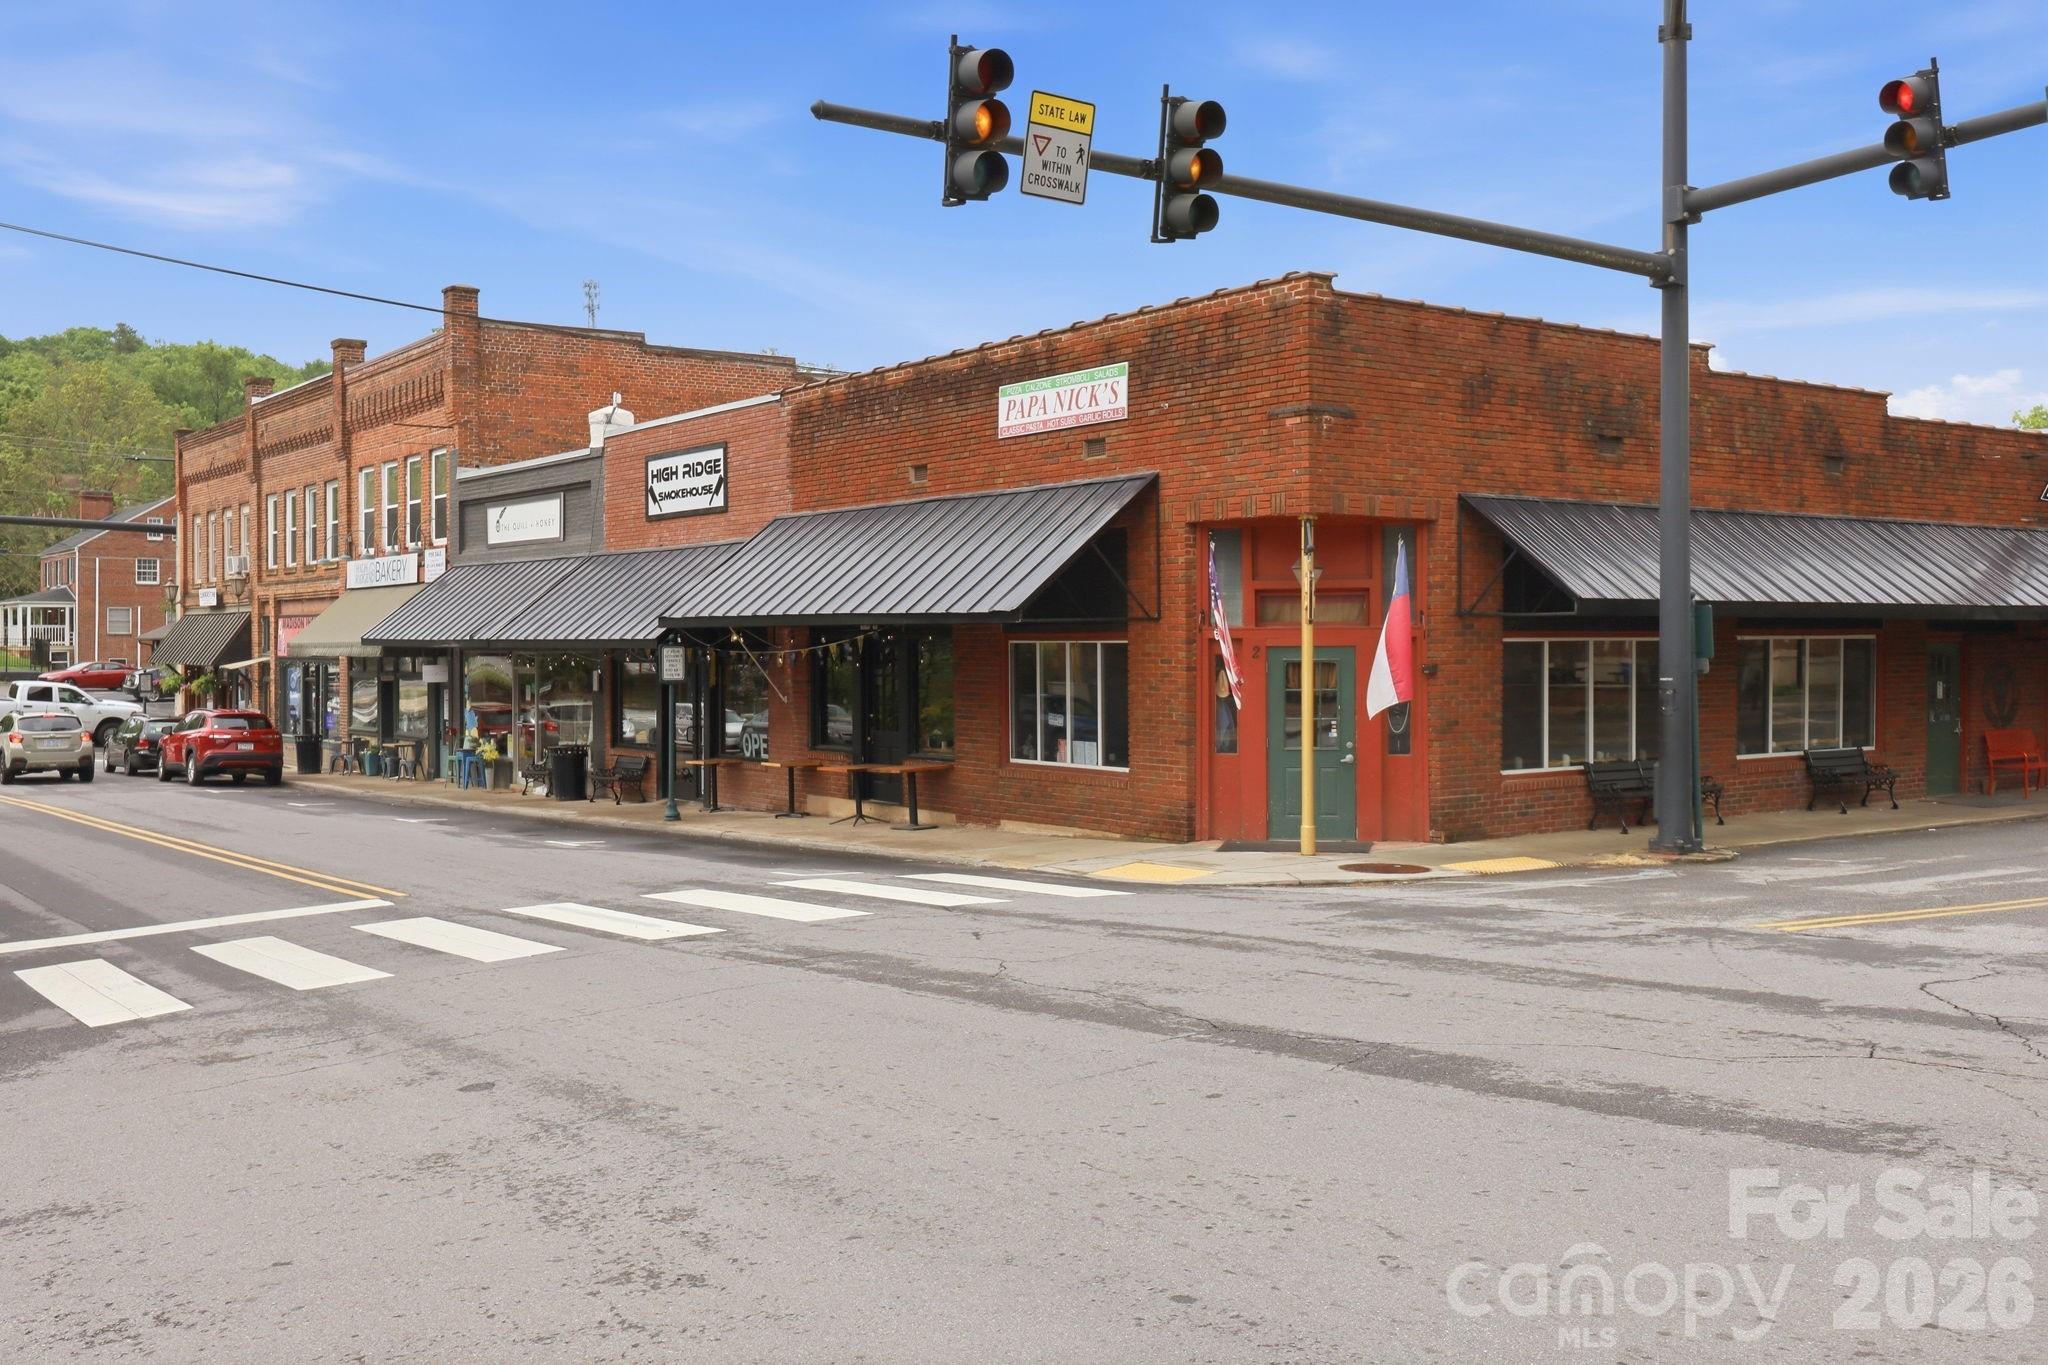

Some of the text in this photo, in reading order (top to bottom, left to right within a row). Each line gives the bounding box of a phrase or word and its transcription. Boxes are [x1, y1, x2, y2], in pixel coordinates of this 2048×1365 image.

[1038, 103, 1087, 125] STATE LAW
[1056, 145, 1067, 159] TO
[1041, 159, 1072, 176] WITHIN
[1027, 172, 1081, 194] CROSSWALK
[1055, 374, 1090, 388] STROMBOLI
[1094, 367, 1119, 380] SALADS
[1005, 380, 1120, 422] PAPA NICK'S
[1001, 407, 1123, 437] CLASSIC PASTA HOT SUBS GARLIC ROLLS
[650, 457, 722, 485] HIGH RIDGE
[658, 483, 714, 502] SMOKEHOUSE
[512, 519, 528, 531] QUILL
[535, 517, 555, 528] HONEY
[375, 557, 408, 583] BAKERY
[282, 616, 305, 630] MADISON
[1252, 646, 1261, 659] 2
[743, 732, 769, 760] OPE
